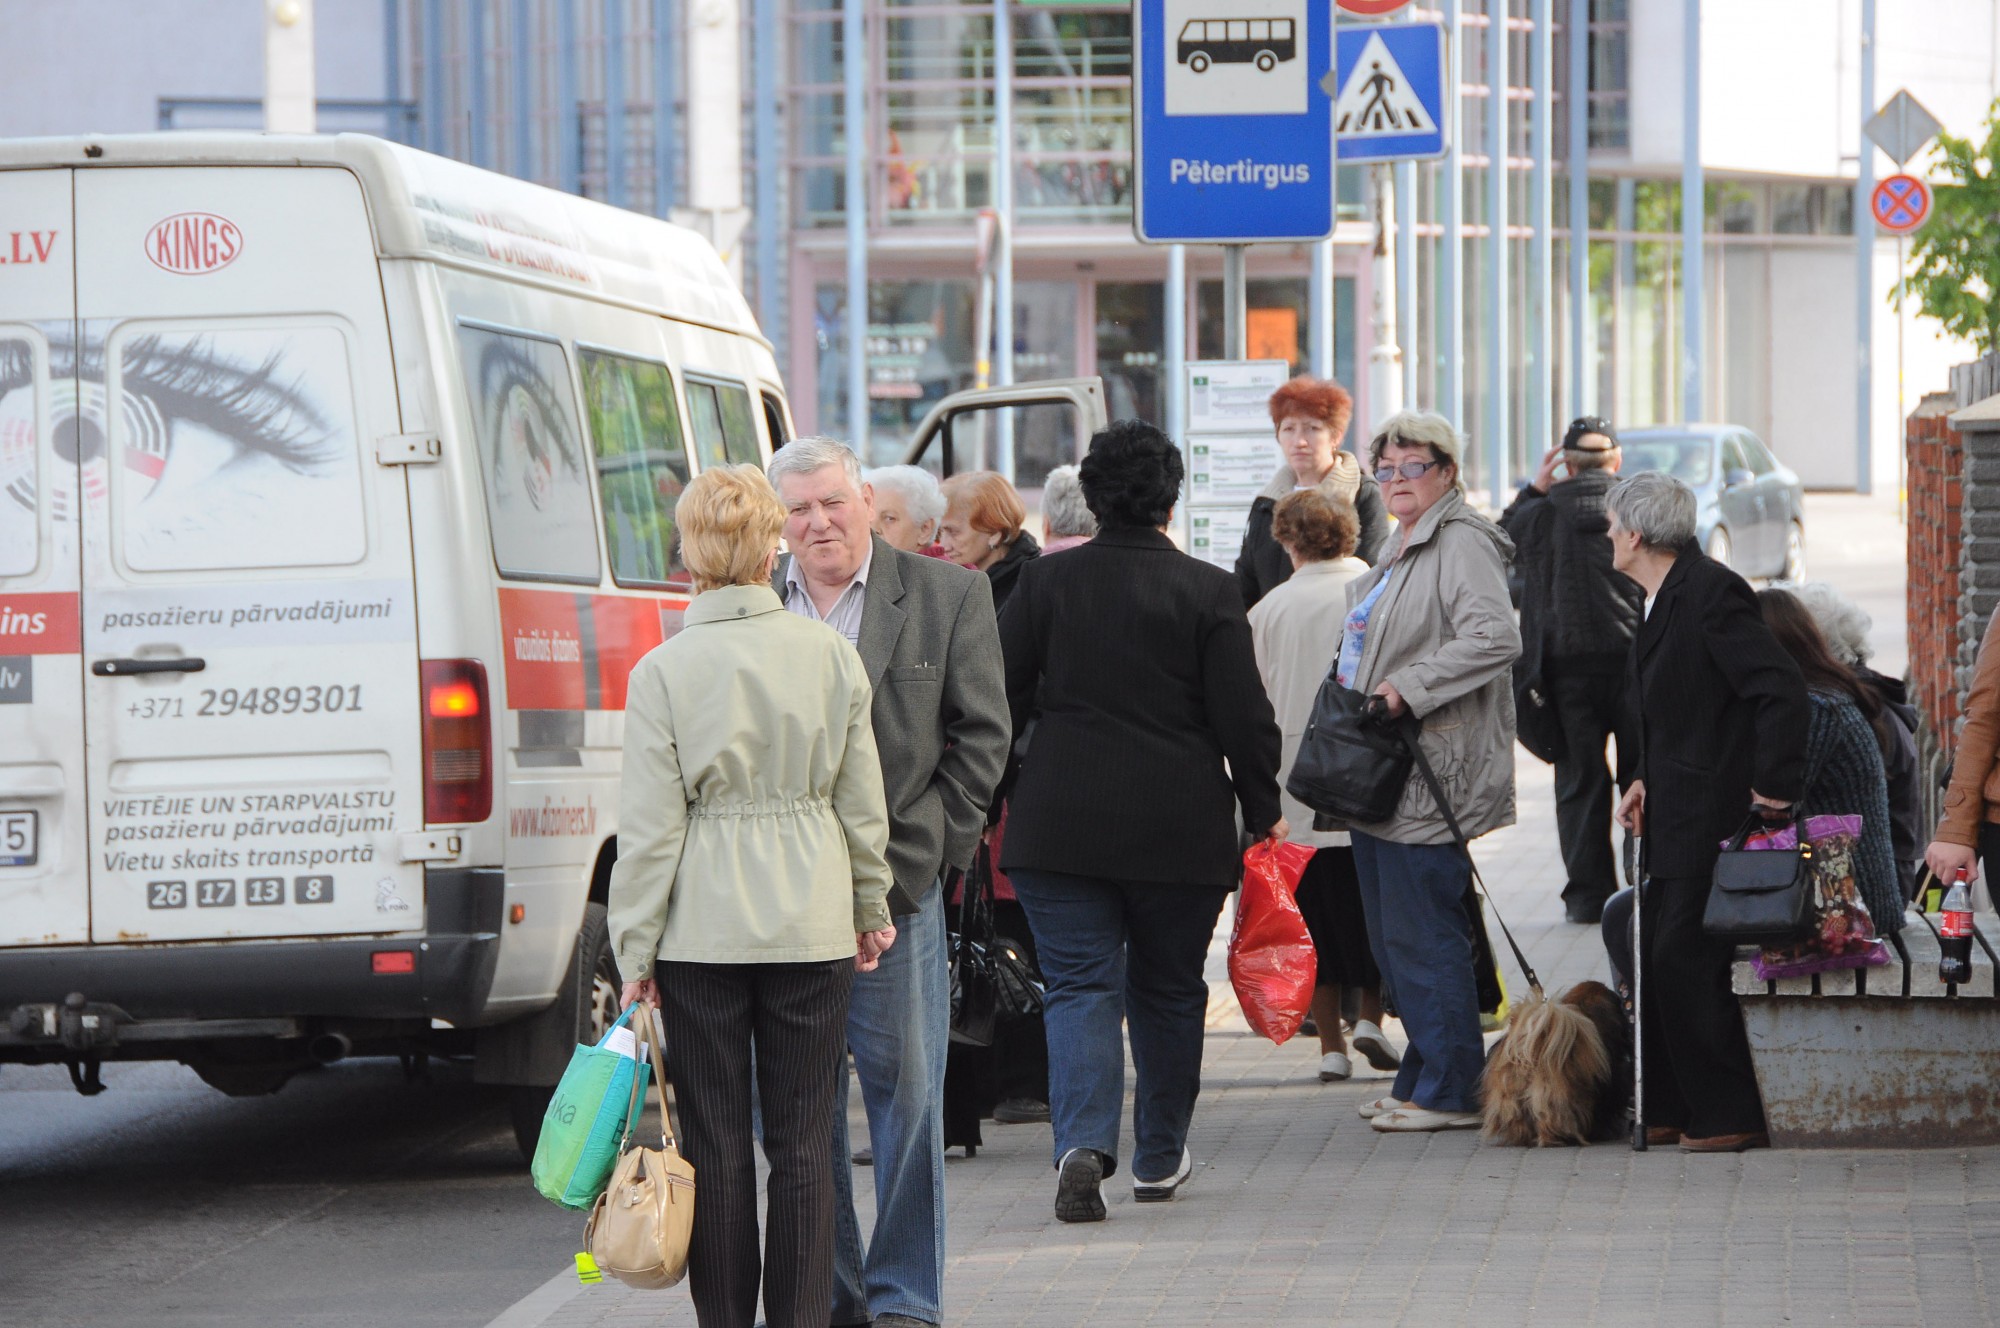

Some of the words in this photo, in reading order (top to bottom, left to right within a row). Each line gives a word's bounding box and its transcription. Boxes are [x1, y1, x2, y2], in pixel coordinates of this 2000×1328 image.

[1170, 158, 1310, 190] Pētertirgus
[0, 230, 57, 264] .LV
[157, 217, 235, 270] KINGS
[0, 606, 47, 635] ins
[101, 606, 223, 633] pasažieru
[230, 598, 392, 628] pārvadājumi
[0, 666, 21, 689] lv
[127, 697, 185, 719] +371
[196, 684, 364, 717] 29489301
[103, 795, 194, 817] VIETĒJIE
[200, 796, 235, 814] UN
[240, 790, 395, 813] STARPVALSTU
[0, 818, 26, 851] 5
[105, 819, 226, 846] pasažieru
[232, 812, 395, 842] pārvadājumi
[104, 851, 165, 872] Vietu
[170, 848, 239, 870] skaits
[247, 843, 374, 870] transportā
[151, 883, 183, 907] 26
[200, 881, 232, 905] 17
[249, 880, 280, 903] 13
[305, 878, 322, 901] 8
